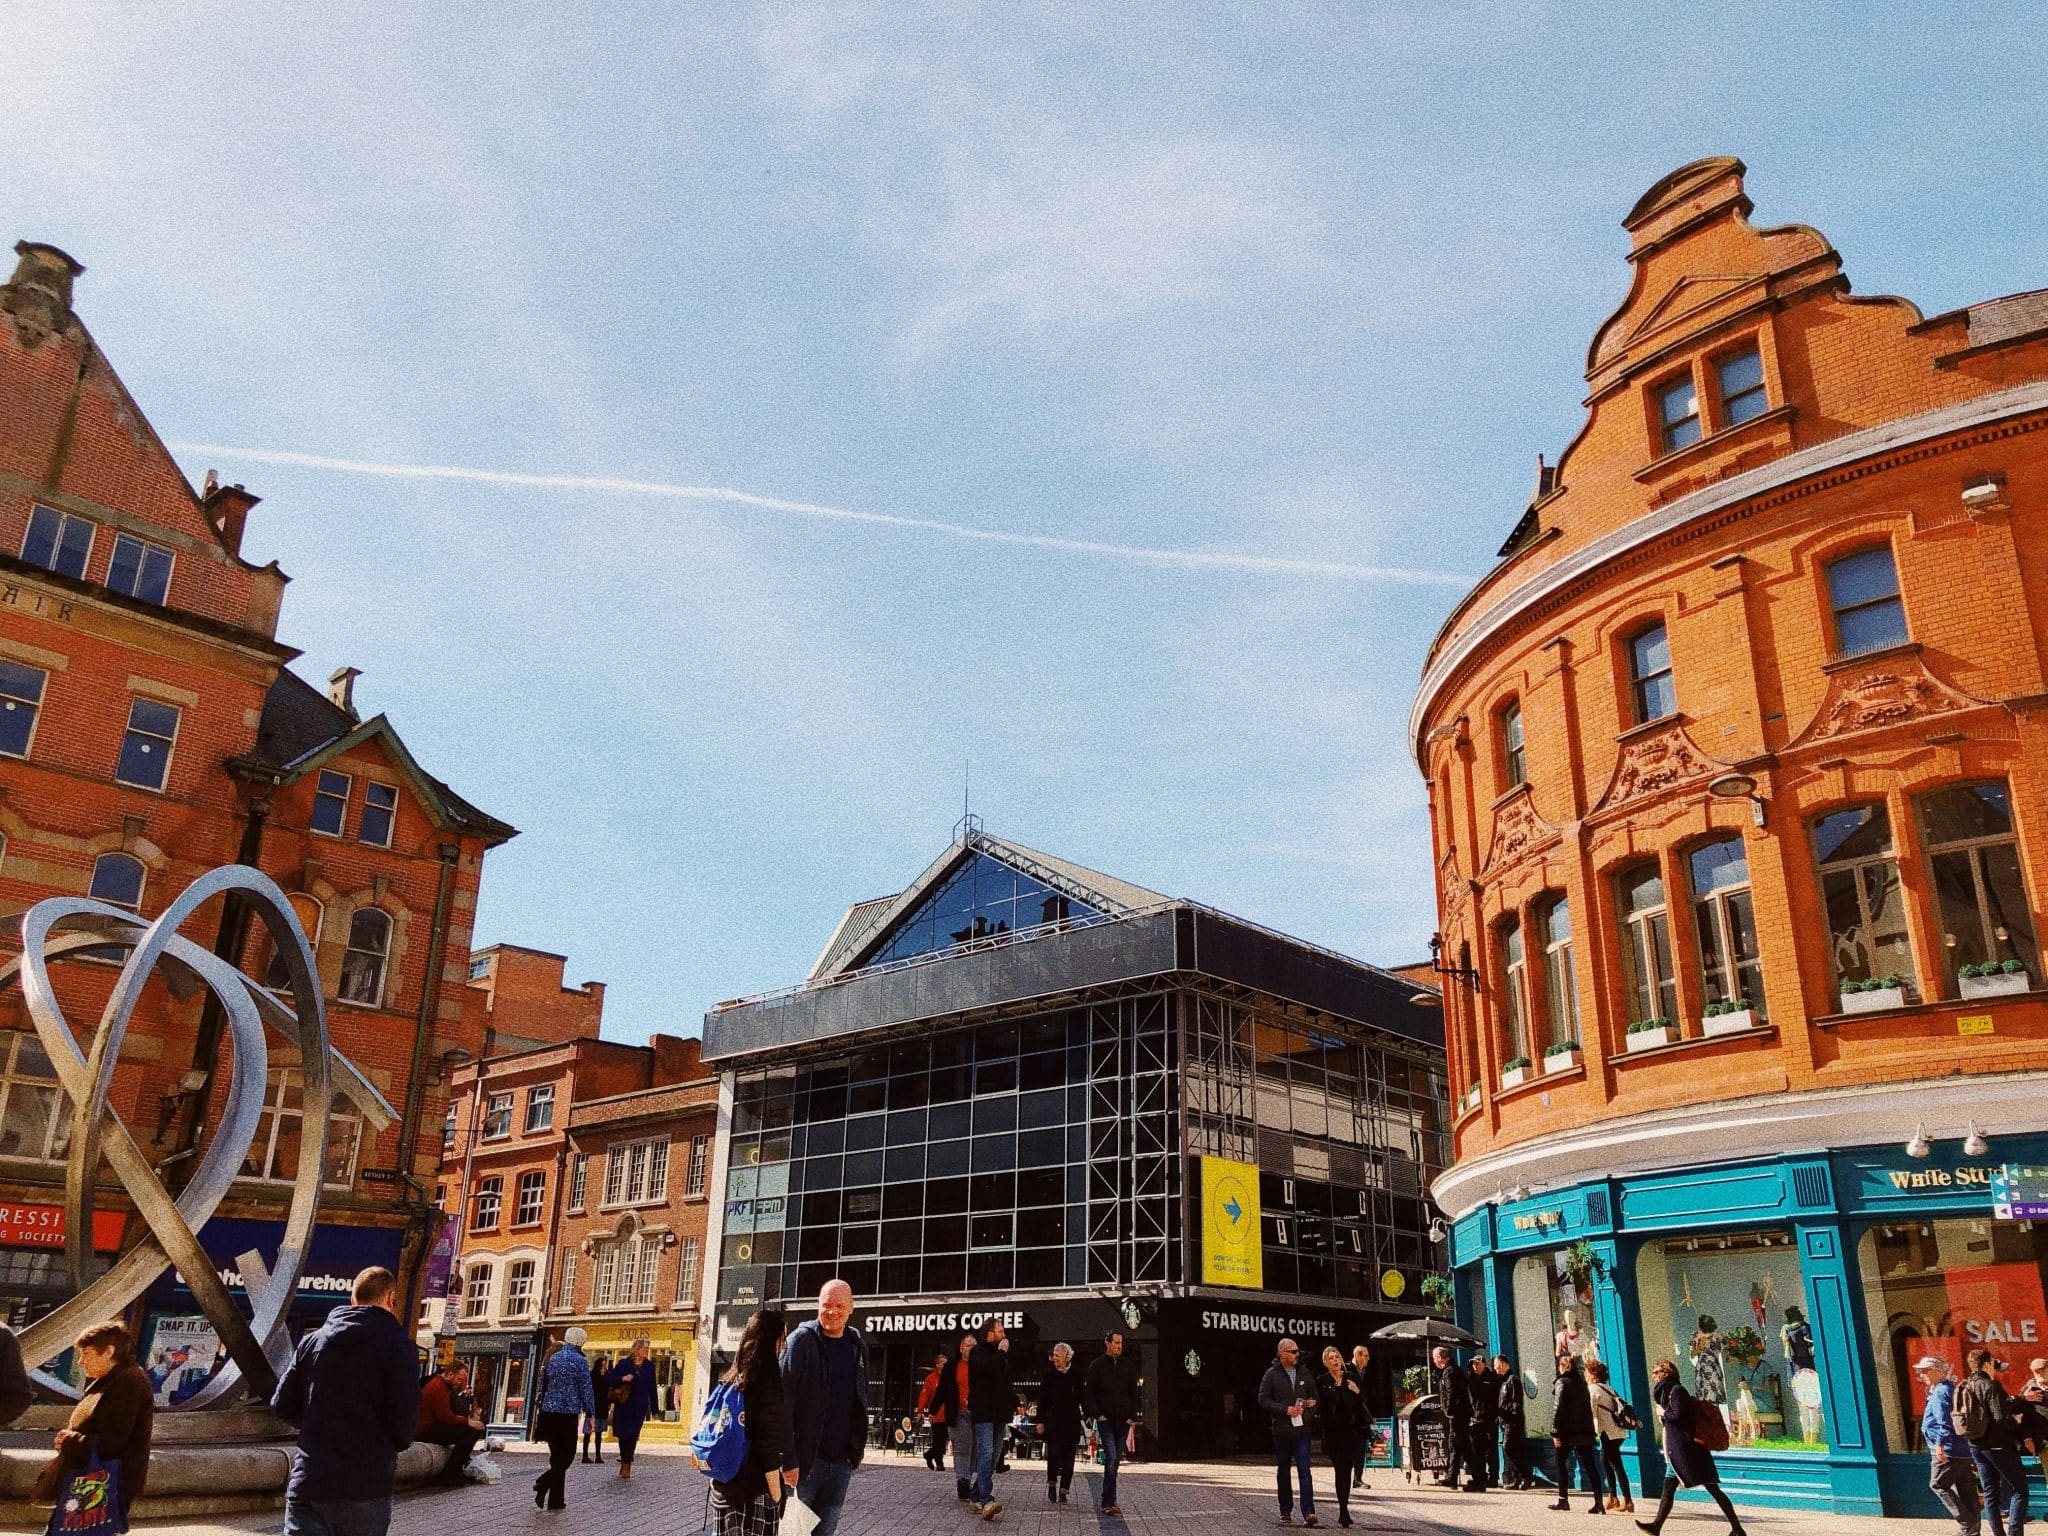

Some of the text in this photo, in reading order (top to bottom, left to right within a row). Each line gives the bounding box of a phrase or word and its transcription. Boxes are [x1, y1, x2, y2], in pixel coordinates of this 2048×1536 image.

[18, 1231, 66, 1242] SOCIETY
[738, 1286, 754, 1295] ROYAL
[732, 1297, 759, 1306] BUILDINGS
[159, 1320, 212, 1333] SNAP. IT. UP.
[865, 1313, 957, 1332] STARBUCKS
[1202, 1311, 1336, 1337] STARBUCKS COFFEE
[618, 1327, 650, 1340] JOULES
[1966, 1319, 2039, 1343] SALE
[1421, 1458, 1448, 1467] TODAY
